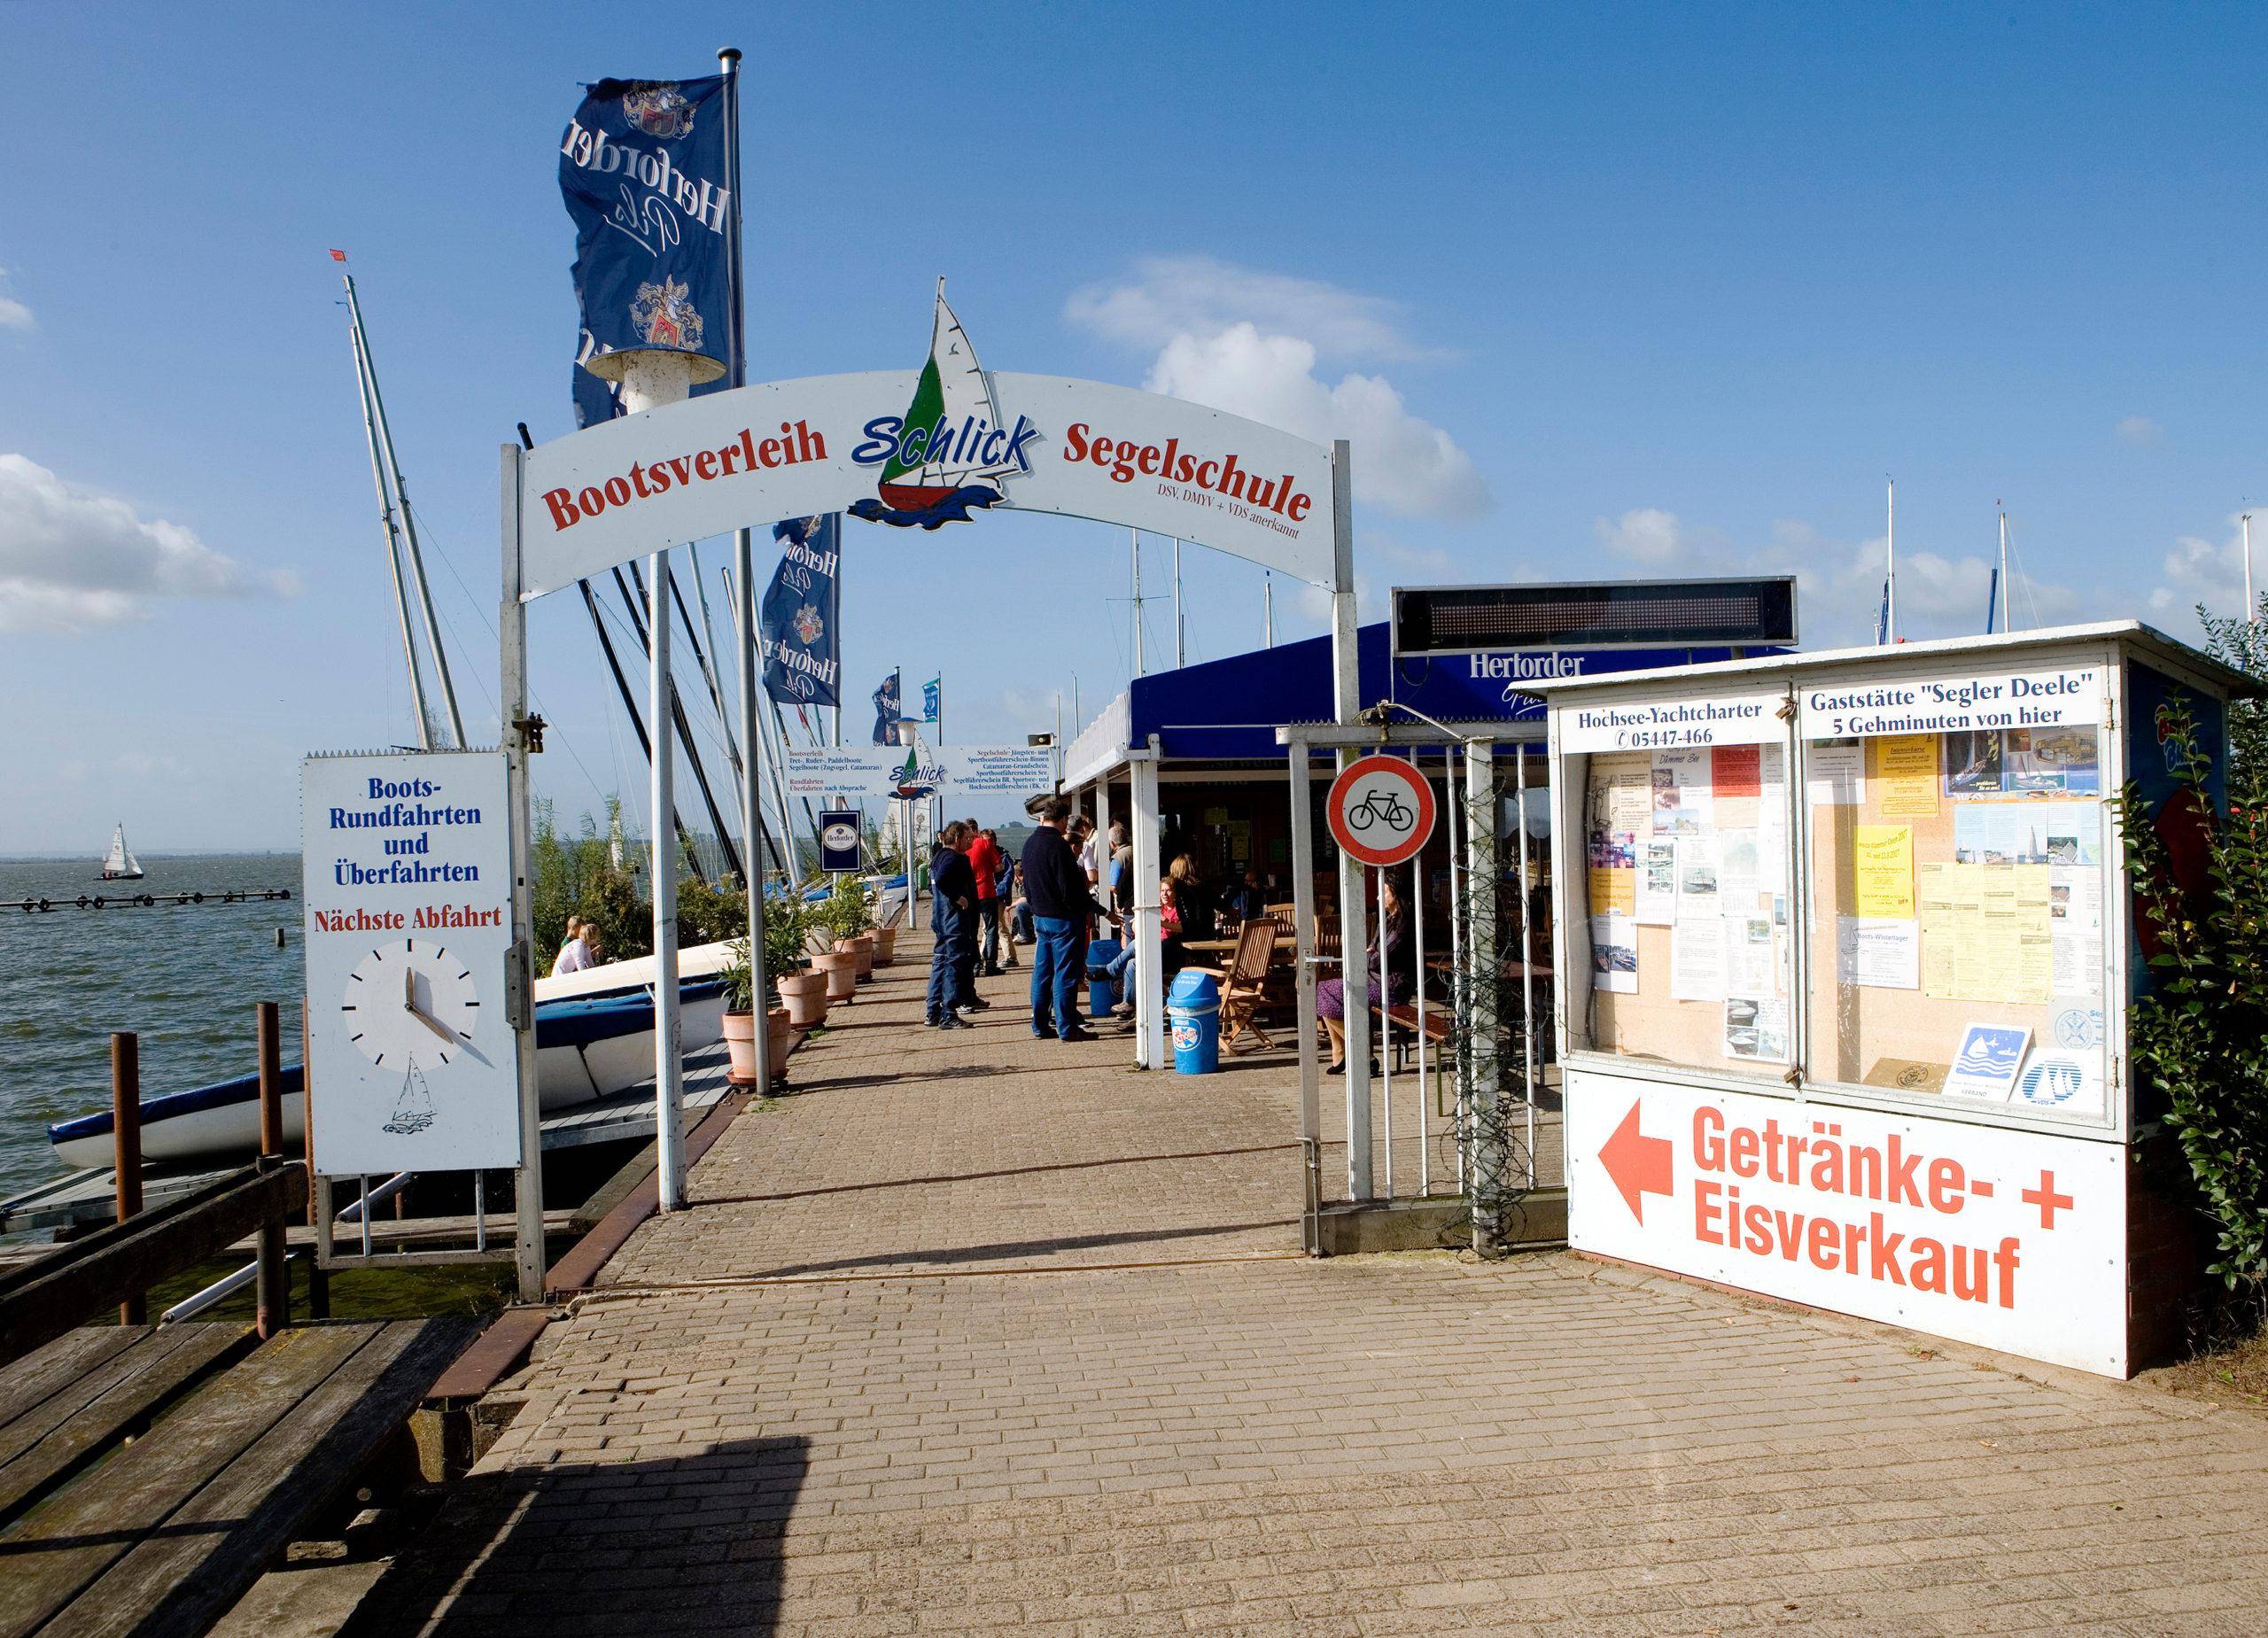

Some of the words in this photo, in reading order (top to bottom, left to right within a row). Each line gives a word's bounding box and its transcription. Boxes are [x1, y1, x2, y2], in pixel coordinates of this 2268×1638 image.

[851, 415, 1038, 472] Schlick
[541, 420, 828, 532] Bootsverleih
[1063, 423, 1312, 522] Segelschule
[1158, 483, 1179, 500] DSV,
[1183, 489, 1215, 508] DMYV
[1216, 502, 1224, 511] +
[1228, 502, 1248, 518] VDS
[1249, 513, 1300, 540] anerkannt
[1470, 652, 1584, 678] Herforder
[1811, 686, 1915, 710] Gaststätte
[1921, 681, 2002, 707] "Segler
[2011, 673, 2093, 698] Deele"
[1579, 703, 1762, 728] Hochsee-Yachtcharter
[1833, 718, 1844, 734] 5
[1849, 710, 1970, 734] Gehminuten
[1976, 712, 2012, 727] von
[2019, 706, 2062, 724] hier
[1631, 728, 1713, 747] 05447-466
[1687, 753, 1700, 764] See
[889, 765, 945, 781] Schlick
[368, 778, 442, 800] Boots-
[330, 803, 482, 829] Rundfahrten
[384, 832, 429, 855] und
[335, 858, 479, 886] Überfahrten
[315, 908, 405, 932] Nächste
[412, 904, 501, 928] Abfahrt
[1692, 1106, 1994, 1215] Getränke-
[2022, 1168, 2074, 1230] +
[1694, 1178, 2022, 1309] Eisverkauf
